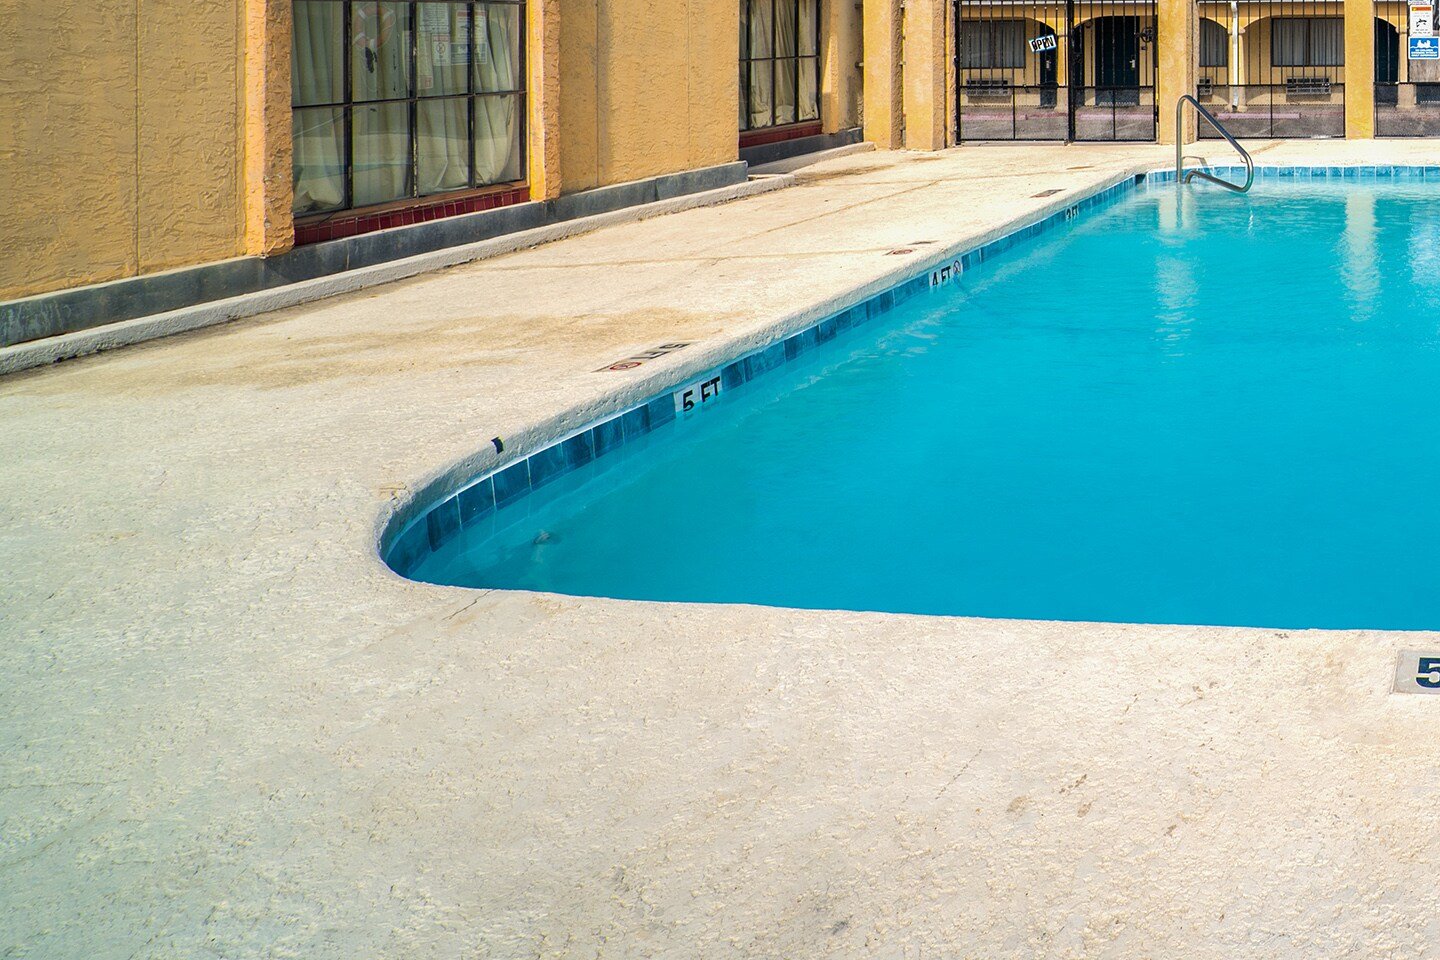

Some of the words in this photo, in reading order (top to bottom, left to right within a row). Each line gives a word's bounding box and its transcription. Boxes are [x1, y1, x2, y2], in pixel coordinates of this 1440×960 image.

[1031, 36, 1054, 51] OPEN
[941, 266, 951, 282] FT
[682, 390, 695, 412] 5
[701, 376, 720, 403] FT
